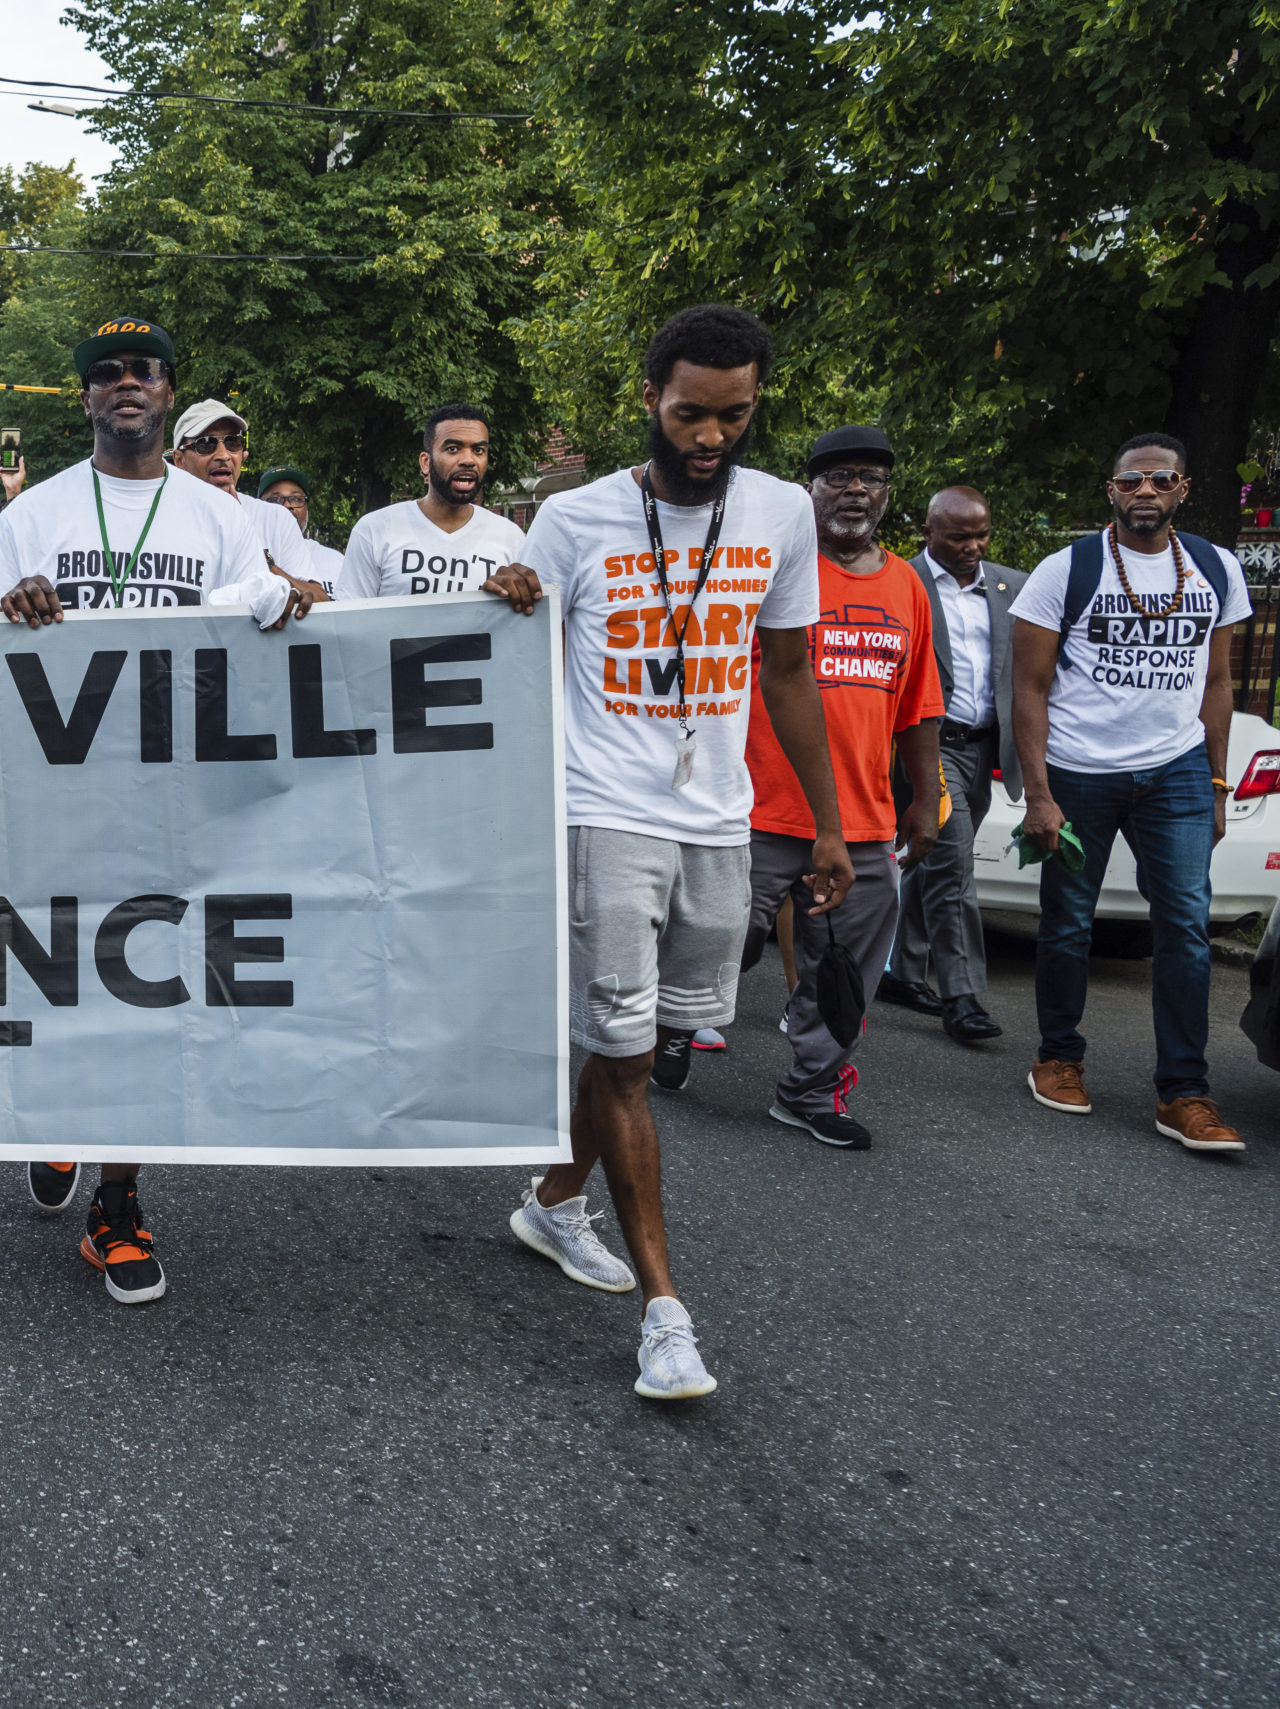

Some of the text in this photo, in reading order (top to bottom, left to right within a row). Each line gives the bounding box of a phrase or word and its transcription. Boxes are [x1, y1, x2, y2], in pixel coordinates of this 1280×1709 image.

[57, 549, 205, 587] BROWNSVILLE
[604, 549, 680, 579] STOP
[688, 547, 772, 570] DYING
[607, 579, 768, 602] FOR YOUR HOMIES
[606, 603, 761, 649] START
[823, 629, 902, 650] NEW YORK
[823, 646, 895, 660] COMMUNITIES
[1098, 647, 1196, 669] RESPONSE
[603, 655, 748, 696] LIVING
[820, 657, 898, 681] CHANGE
[1092, 666, 1195, 691] COALITION
[644, 703, 693, 719] YOUR
[696, 698, 742, 717] FAMILY
